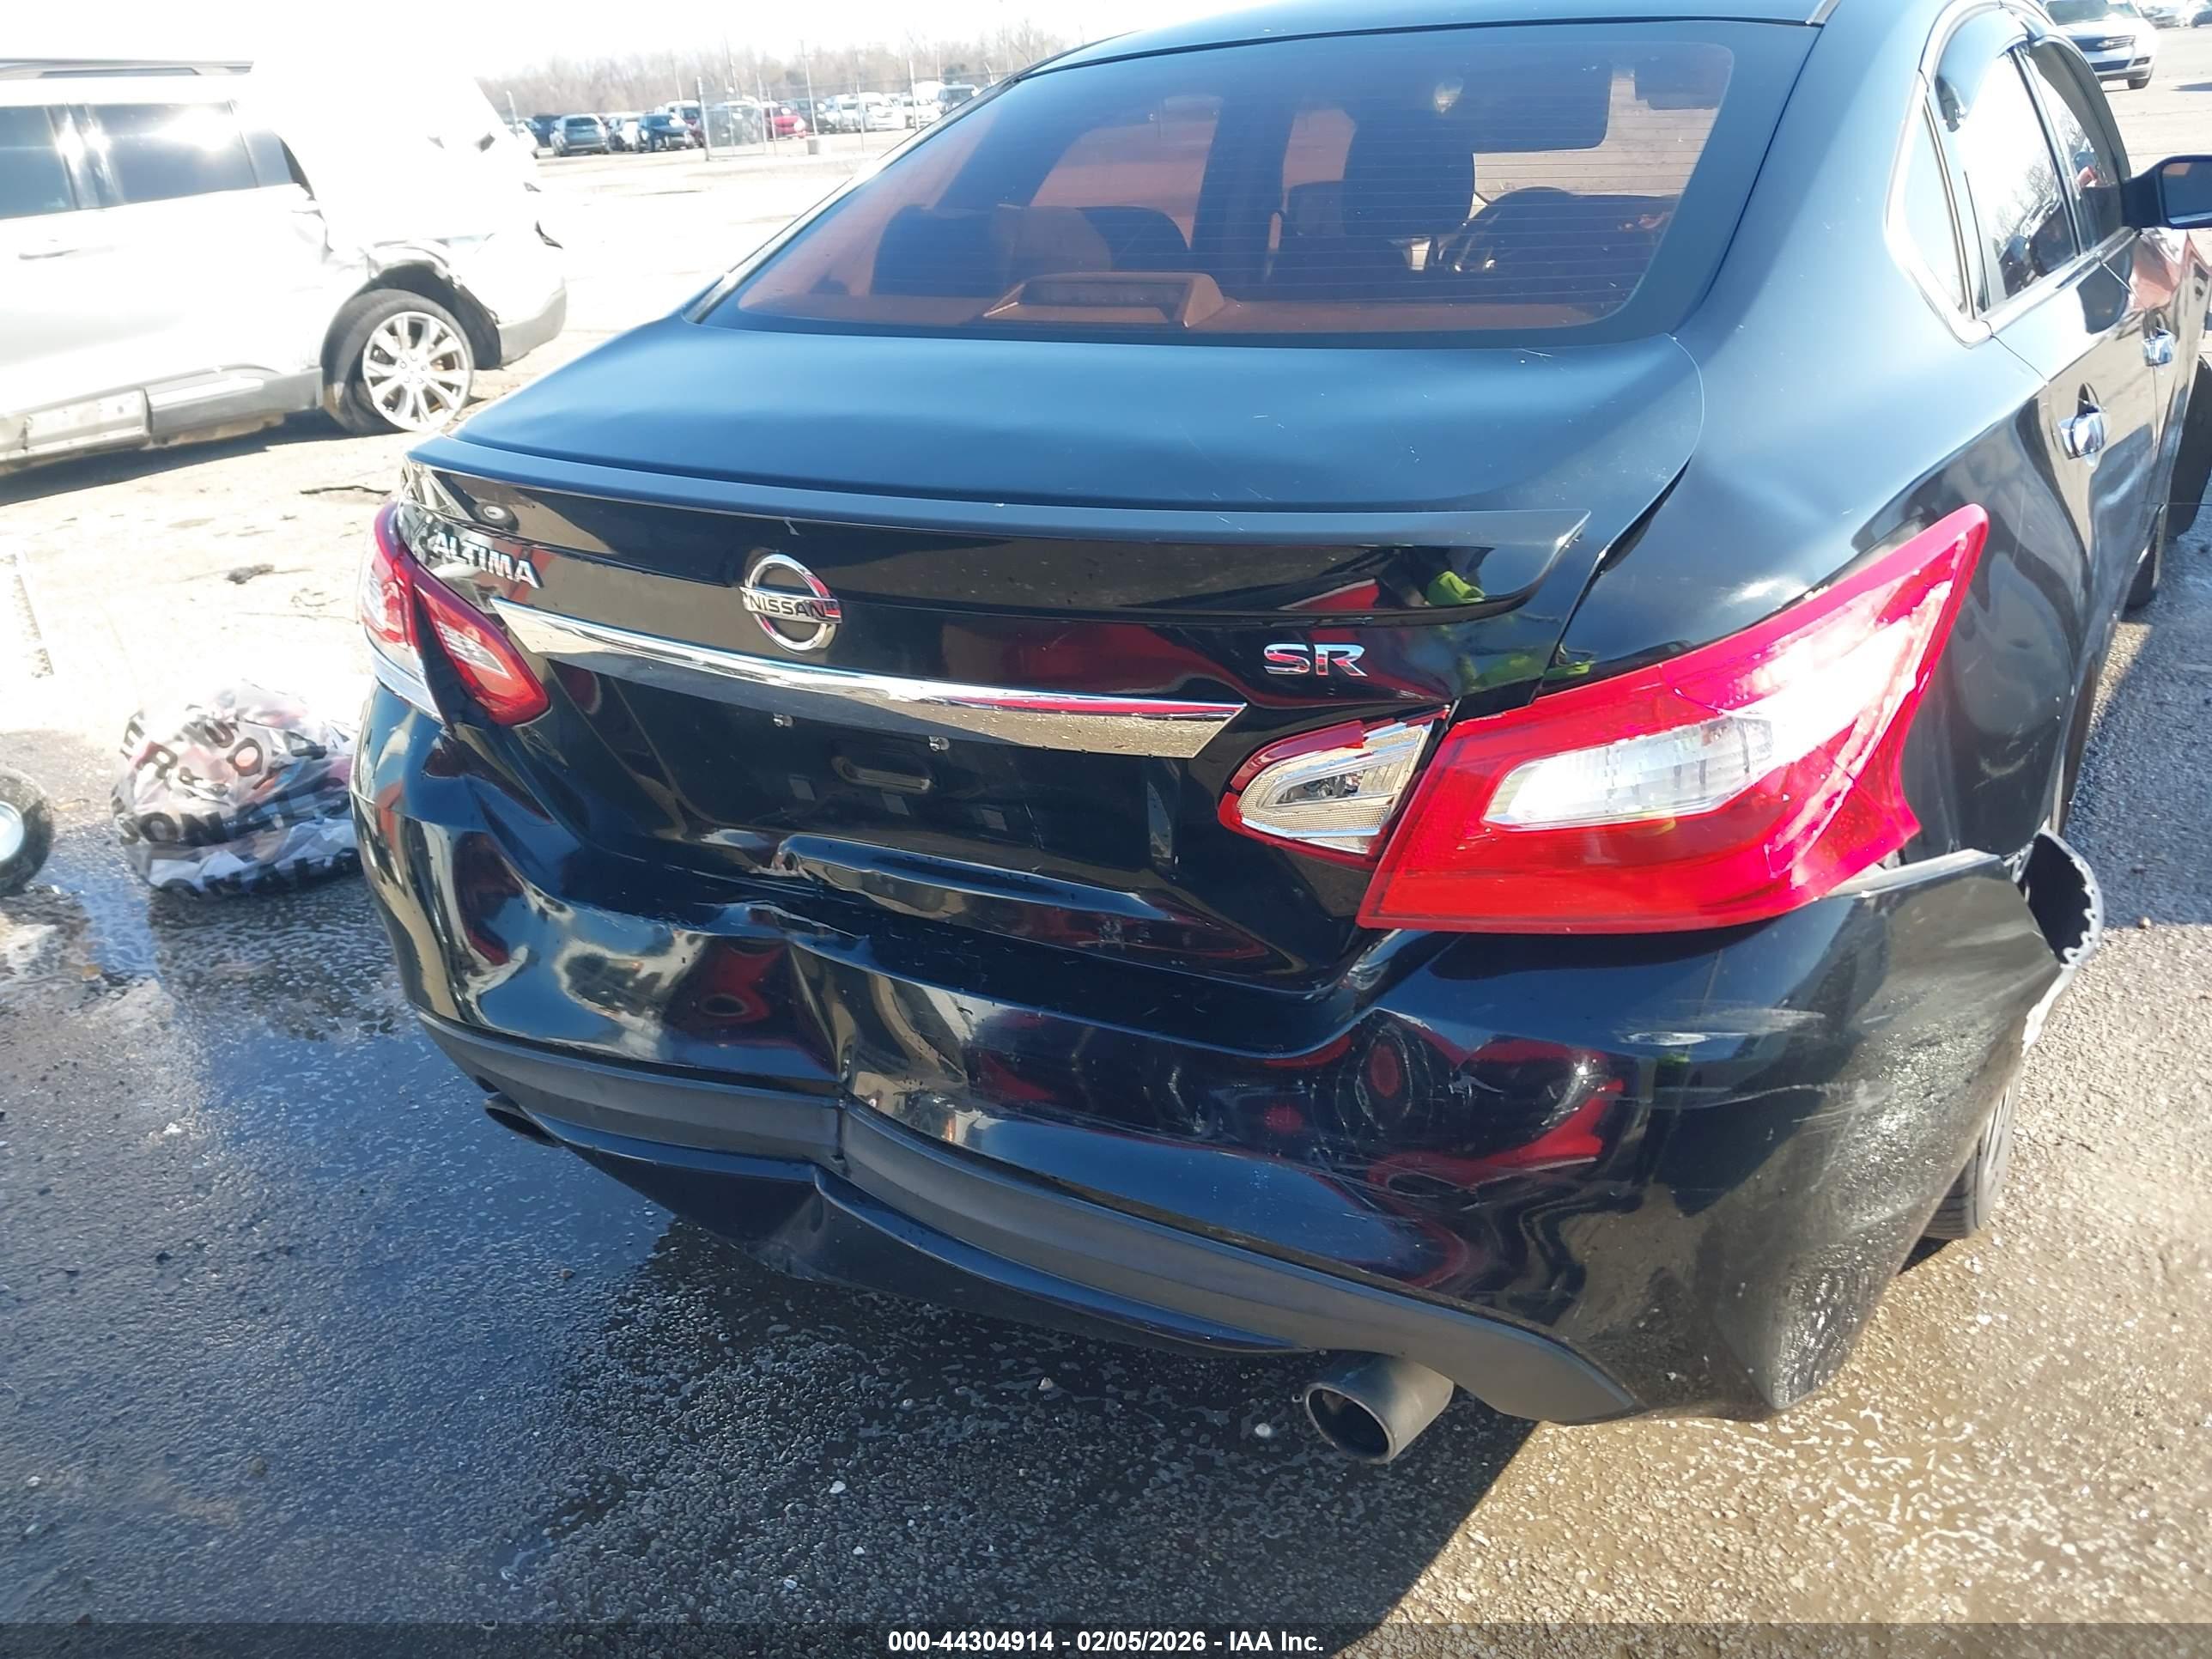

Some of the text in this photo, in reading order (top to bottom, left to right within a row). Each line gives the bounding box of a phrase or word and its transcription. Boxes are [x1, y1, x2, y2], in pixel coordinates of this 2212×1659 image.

[432, 531, 544, 589] ALTIMA
[749, 593, 827, 617] NISSAN
[1263, 643, 1368, 678] SR
